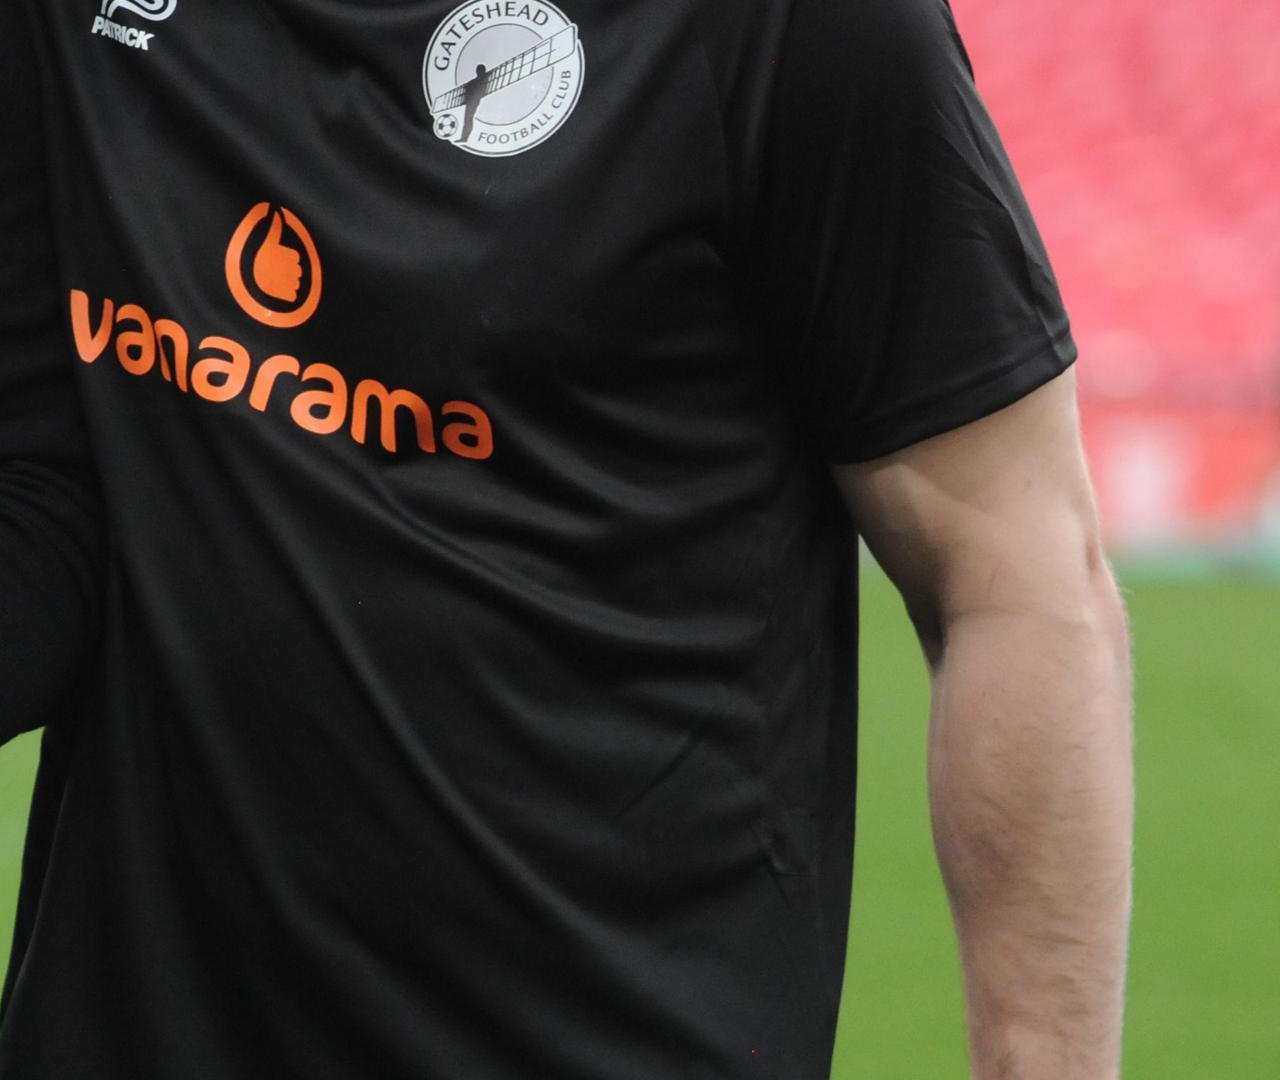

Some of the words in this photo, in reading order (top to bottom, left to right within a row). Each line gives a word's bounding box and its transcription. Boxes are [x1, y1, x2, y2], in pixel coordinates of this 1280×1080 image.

[91, 15, 155, 51] PATRICK
[434, 1, 549, 71] GATESHEAD
[477, 112, 553, 145] FOOTBALL
[551, 69, 572, 109] CLUB
[69, 288, 494, 461] vanarama
